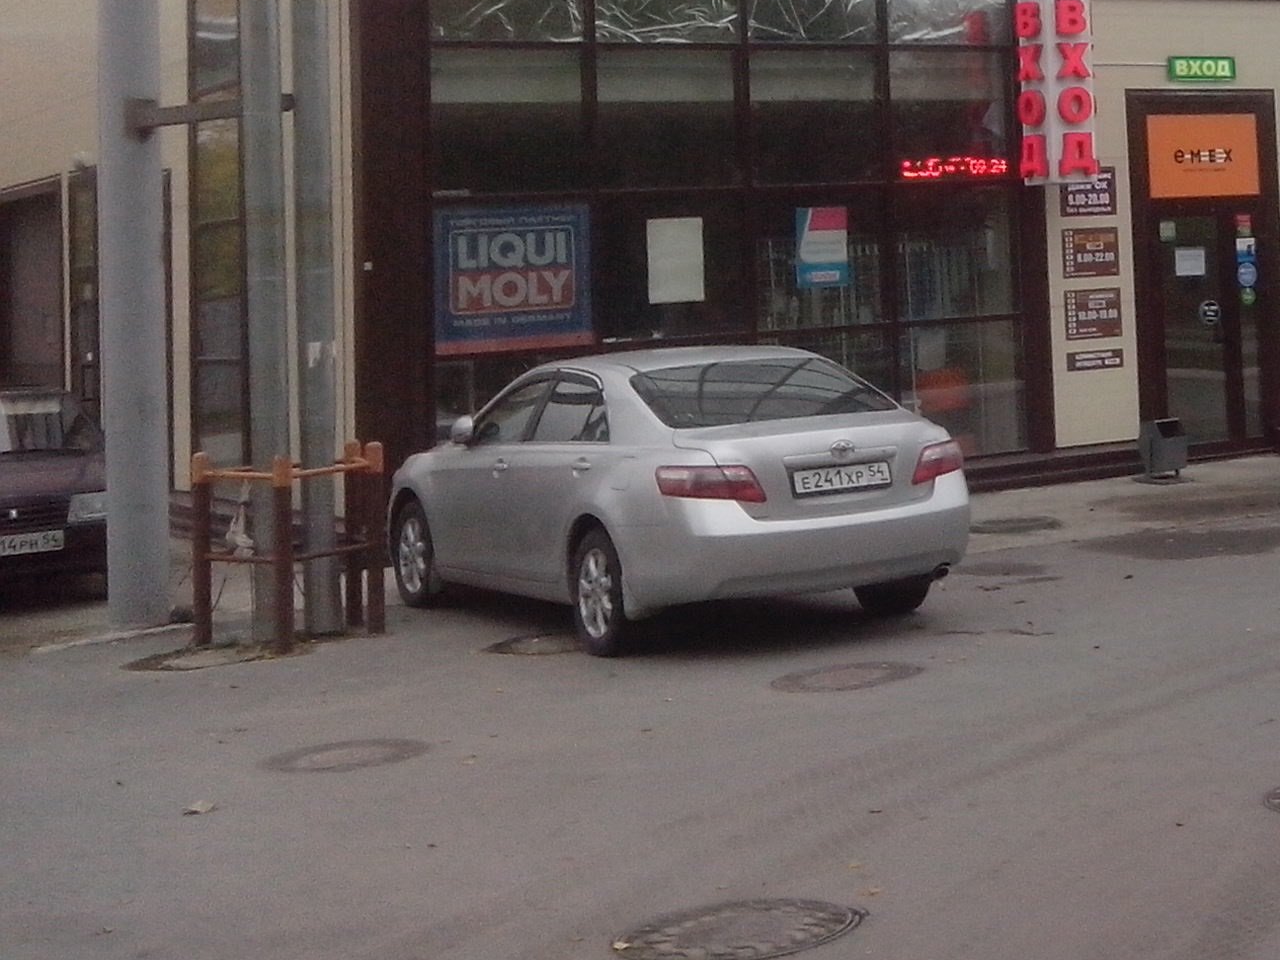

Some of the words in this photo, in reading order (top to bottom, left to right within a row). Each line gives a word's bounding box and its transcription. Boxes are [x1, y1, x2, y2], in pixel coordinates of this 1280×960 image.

[1175, 60, 1233, 77] ВХОД
[1015, 1, 1049, 178] ВХОД
[457, 231, 567, 269] LIQUI
[457, 270, 571, 308] MOLY
[868, 464, 885, 478] 54
